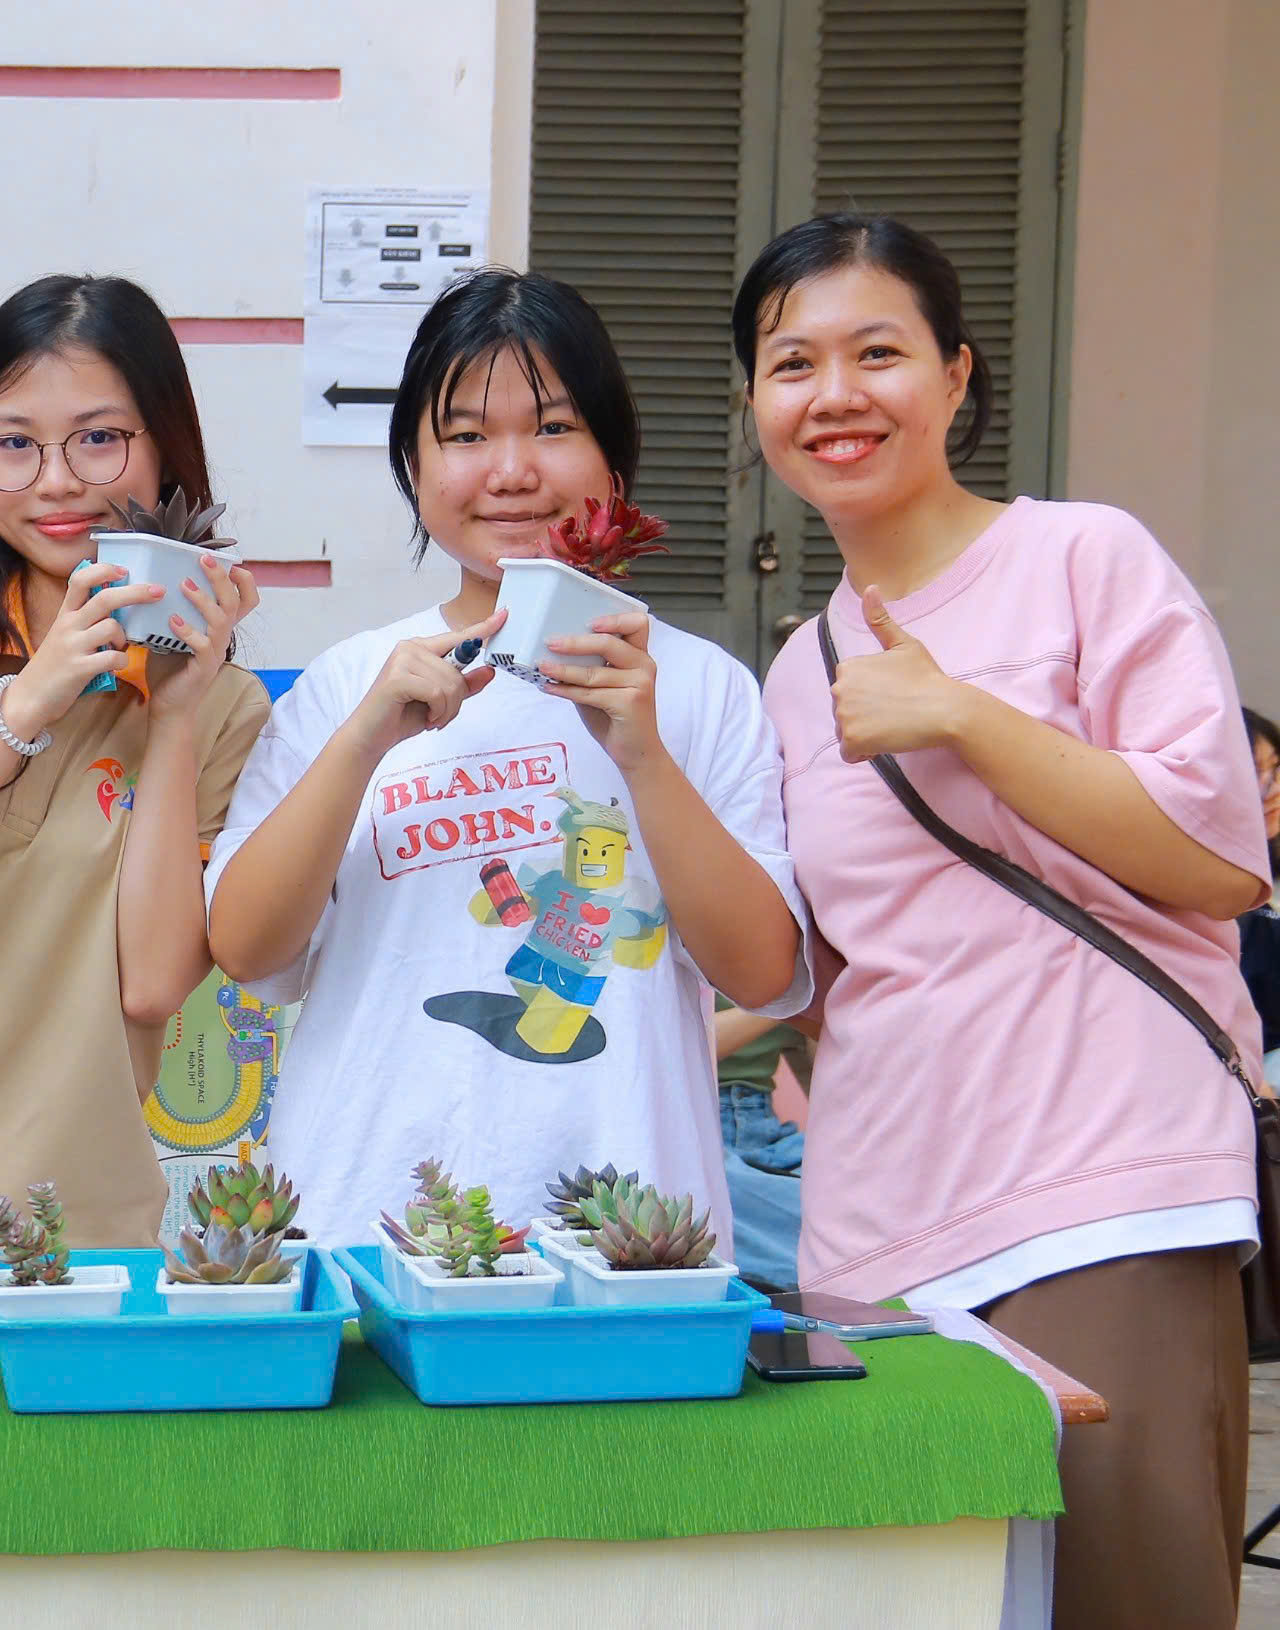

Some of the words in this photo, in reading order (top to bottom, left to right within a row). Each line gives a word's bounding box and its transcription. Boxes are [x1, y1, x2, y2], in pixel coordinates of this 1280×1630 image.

[380, 755, 556, 815] BLAME
[396, 804, 552, 860] JOHN.
[552, 890, 574, 912] I
[535, 925, 591, 962] CHICKEN
[543, 911, 603, 949] FRIED
[222, 991, 230, 1001] Pc
[187, 1051, 196, 1069] High
[197, 1032, 205, 1078] THYLAKOID
[197, 1080, 205, 1105] SPACE
